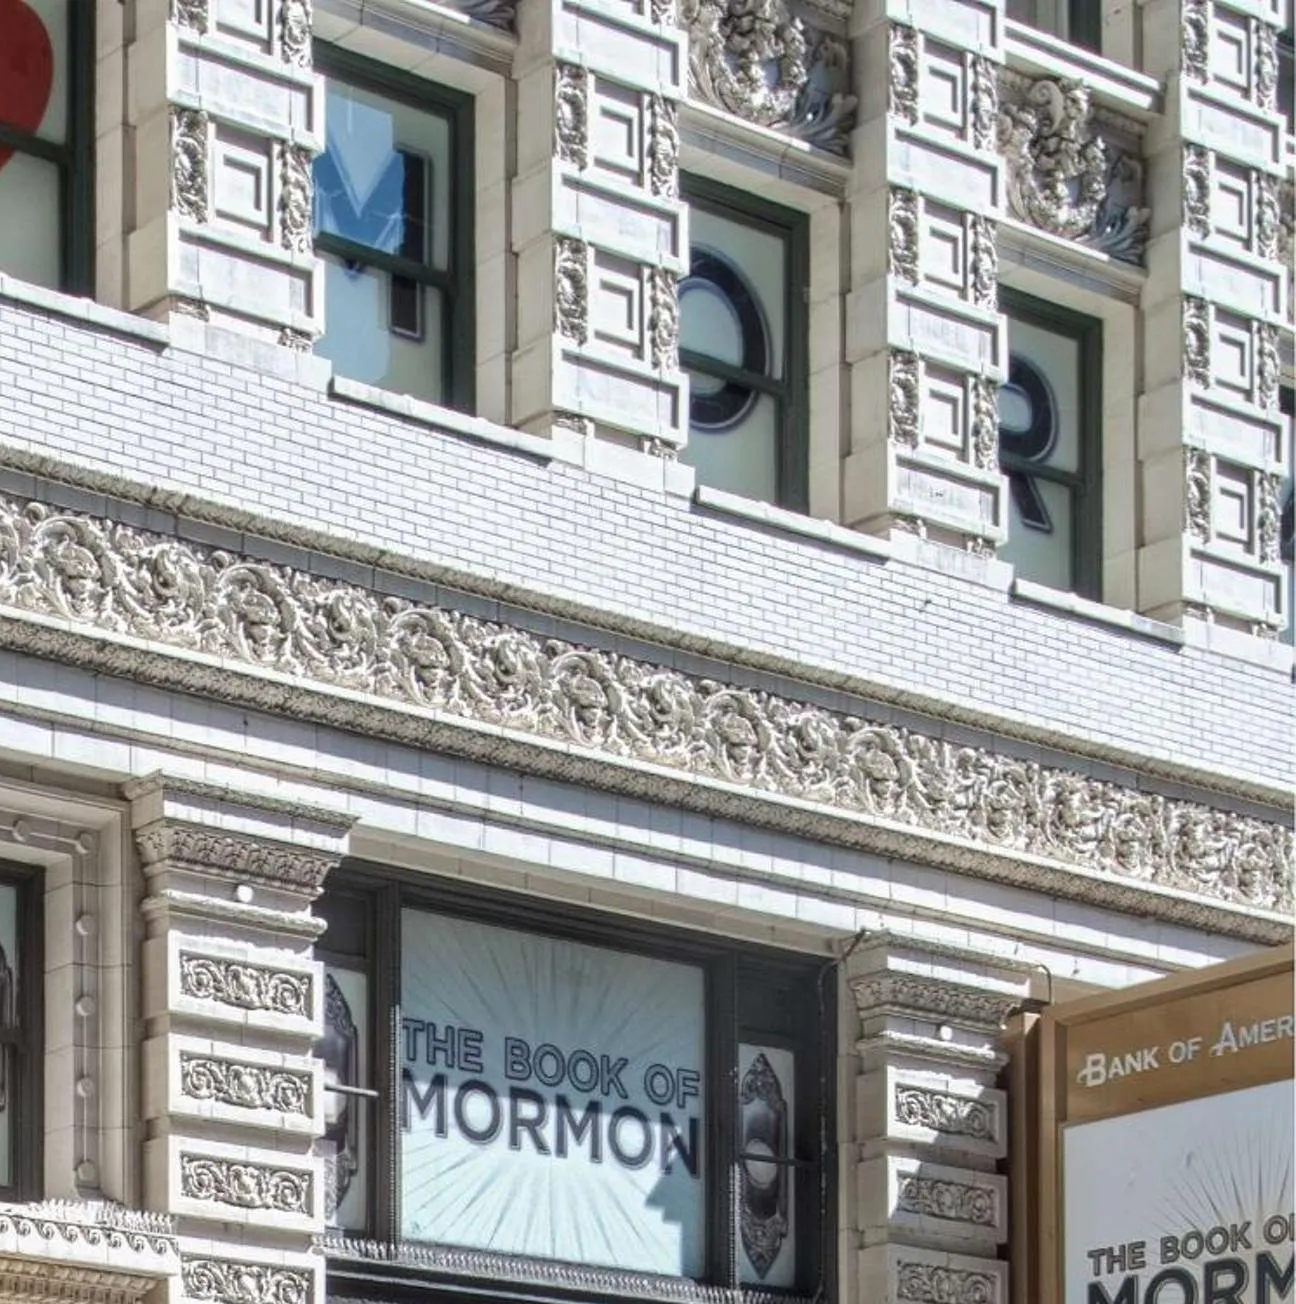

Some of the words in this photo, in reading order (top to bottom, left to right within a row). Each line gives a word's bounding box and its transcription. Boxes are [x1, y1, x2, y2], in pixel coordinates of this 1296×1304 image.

[402, 1017, 484, 1074] THE
[504, 1036, 629, 1100] BOOK
[644, 1063, 701, 1109] OF
[402, 1067, 701, 1180] MORMON
[1087, 1240, 1146, 1277] THE
[1160, 1220, 1253, 1265] BOOK
